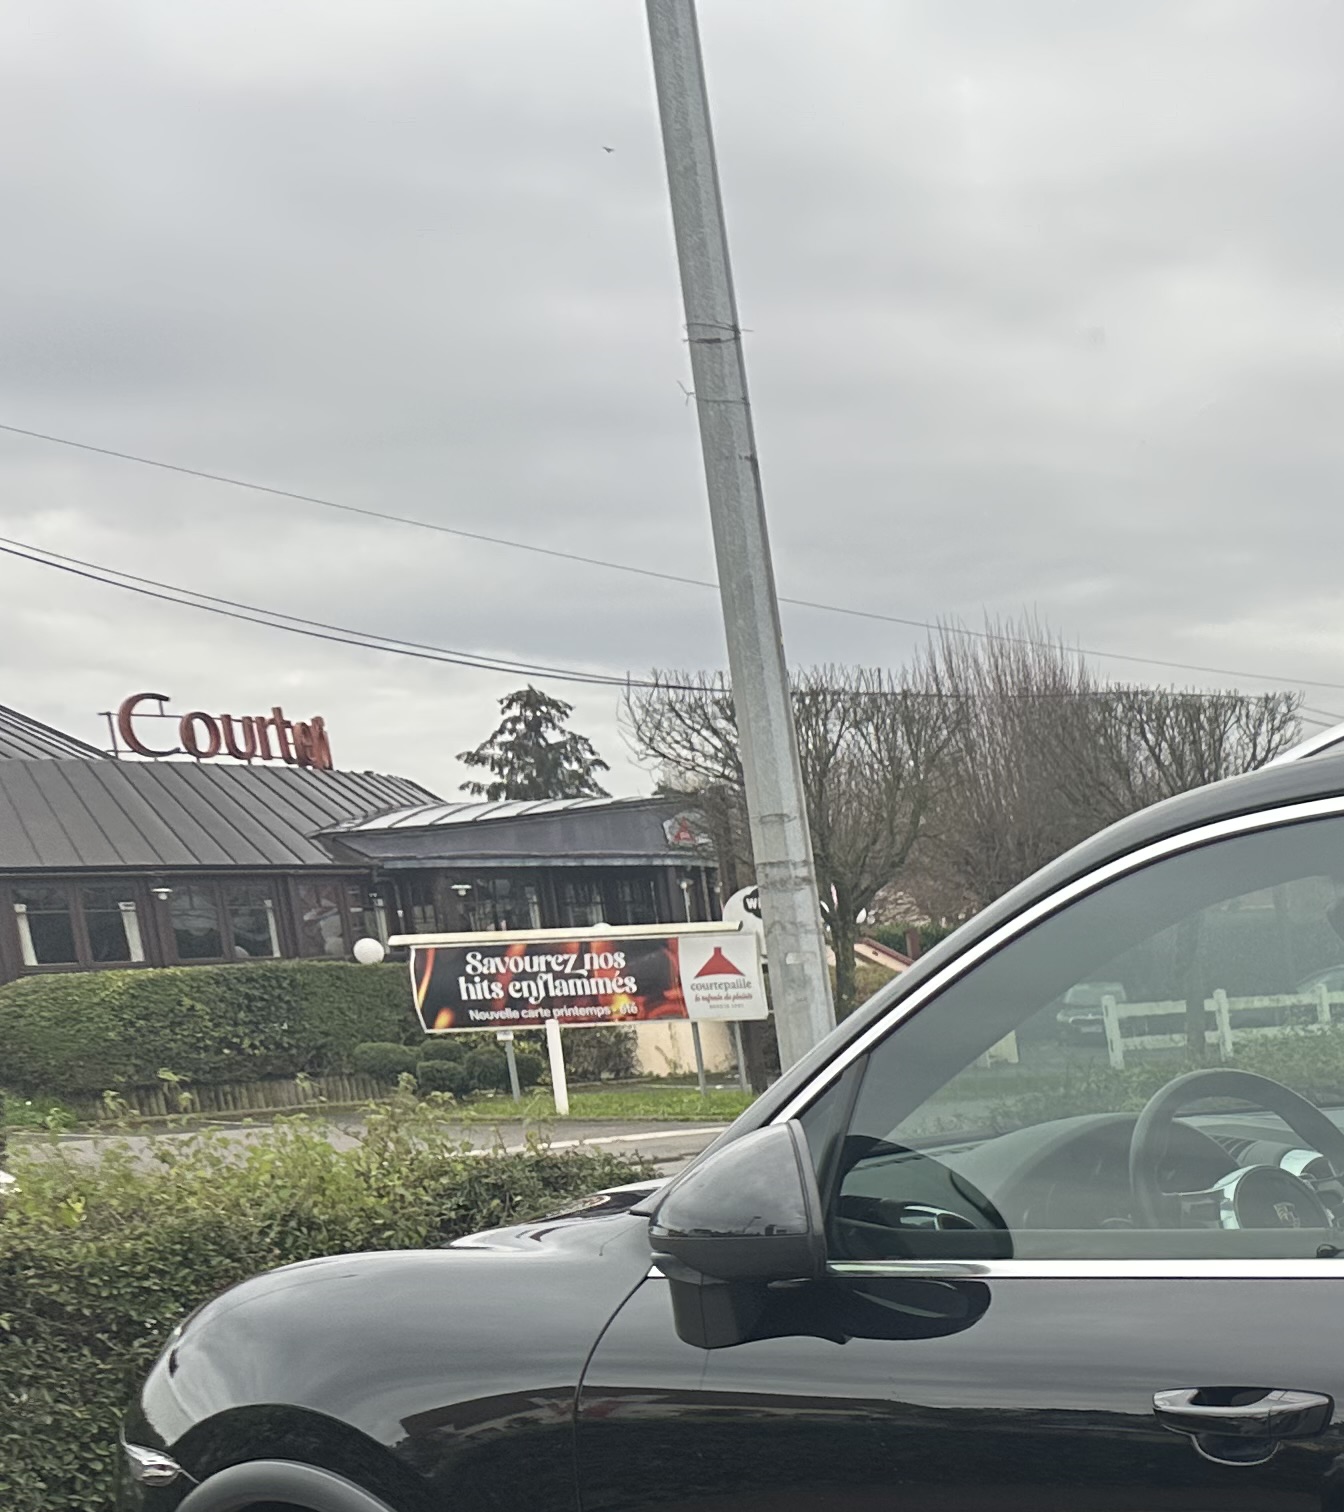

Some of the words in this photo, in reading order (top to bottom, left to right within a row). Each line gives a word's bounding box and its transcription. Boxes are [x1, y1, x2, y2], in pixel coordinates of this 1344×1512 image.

[465, 951, 588, 976] Savourez
[584, 951, 626, 970] nos
[458, 976, 505, 1001] hits
[508, 970, 638, 1005] enflammés
[468, 1008, 520, 1021] Nouvelle
[521, 1006, 551, 1019] carte
[552, 1004, 611, 1019] printemps
